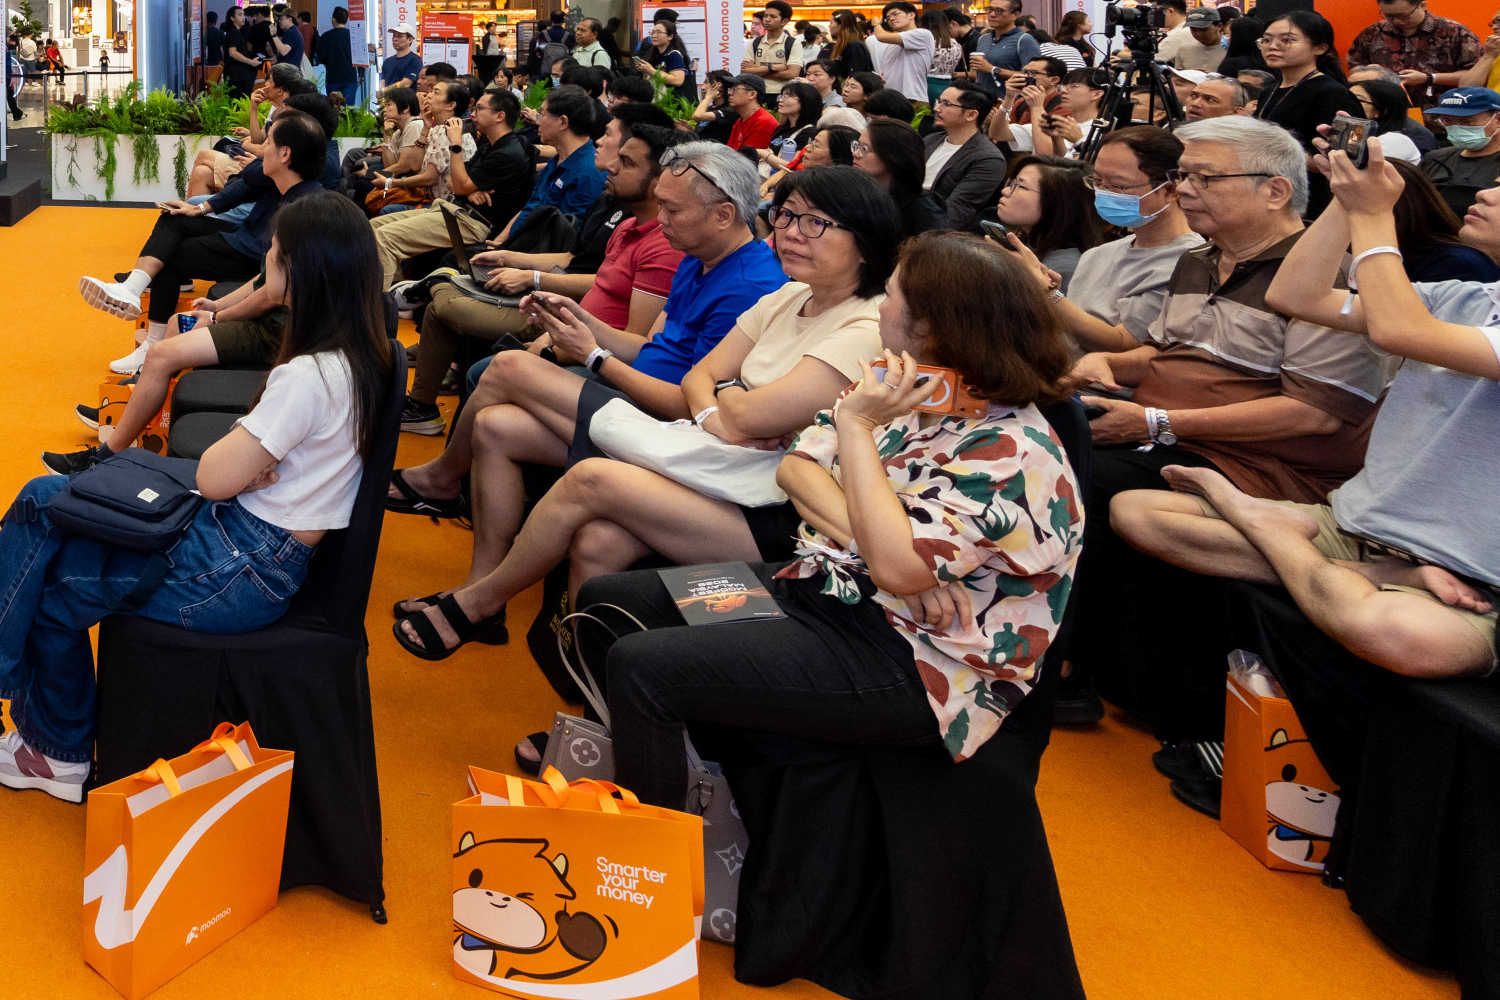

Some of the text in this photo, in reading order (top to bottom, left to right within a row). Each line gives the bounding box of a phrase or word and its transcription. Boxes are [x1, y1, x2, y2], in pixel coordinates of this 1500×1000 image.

[718, 1, 730, 53] Moomoo
[721, 55, 730, 74] ew
[596, 856, 668, 885] Smarter
[601, 873, 639, 892] your
[596, 884, 654, 910] money
[200, 907, 232, 933] moomoo
